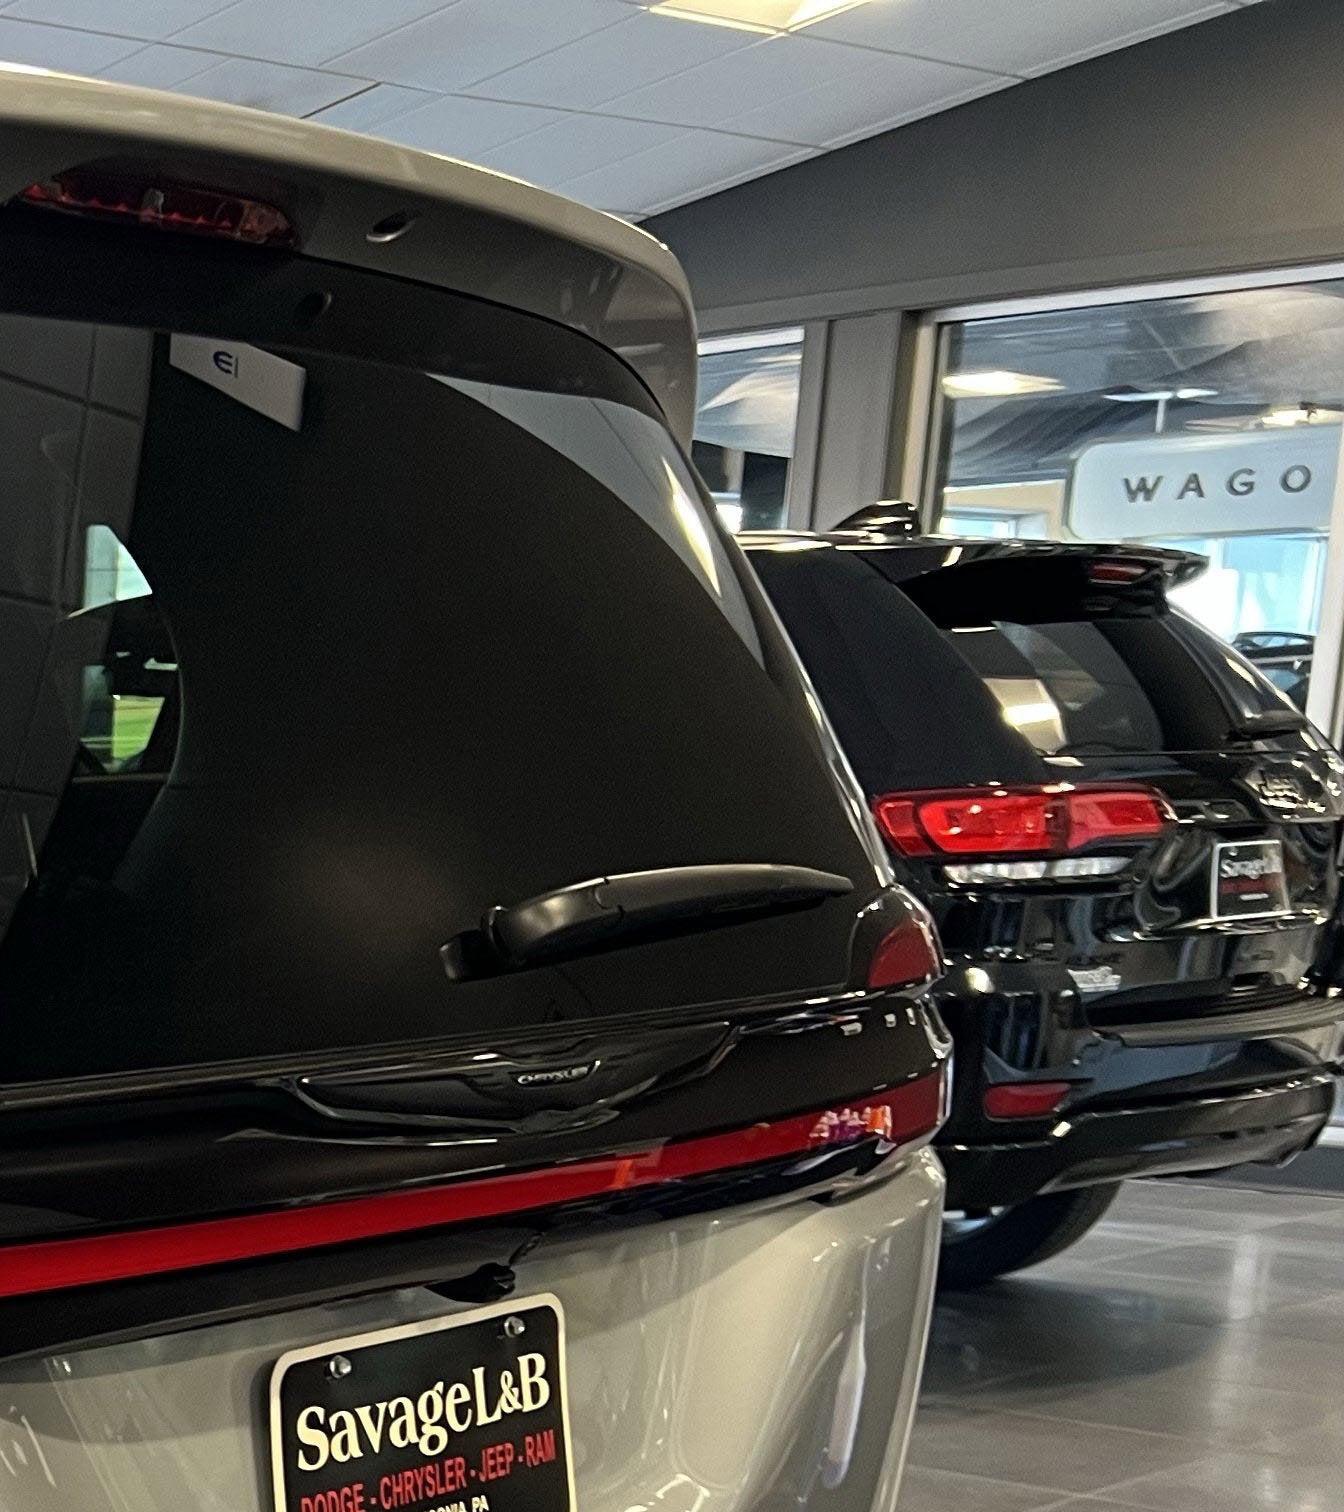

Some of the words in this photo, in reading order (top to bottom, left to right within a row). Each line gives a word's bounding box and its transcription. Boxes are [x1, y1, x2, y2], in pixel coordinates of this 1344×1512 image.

[1123, 464, 1312, 503] WAGO
[379, 1456, 467, 1511] CHRYSLER
[479, 1442, 515, 1483] JEEP
[524, 1429, 557, 1468] RAM
